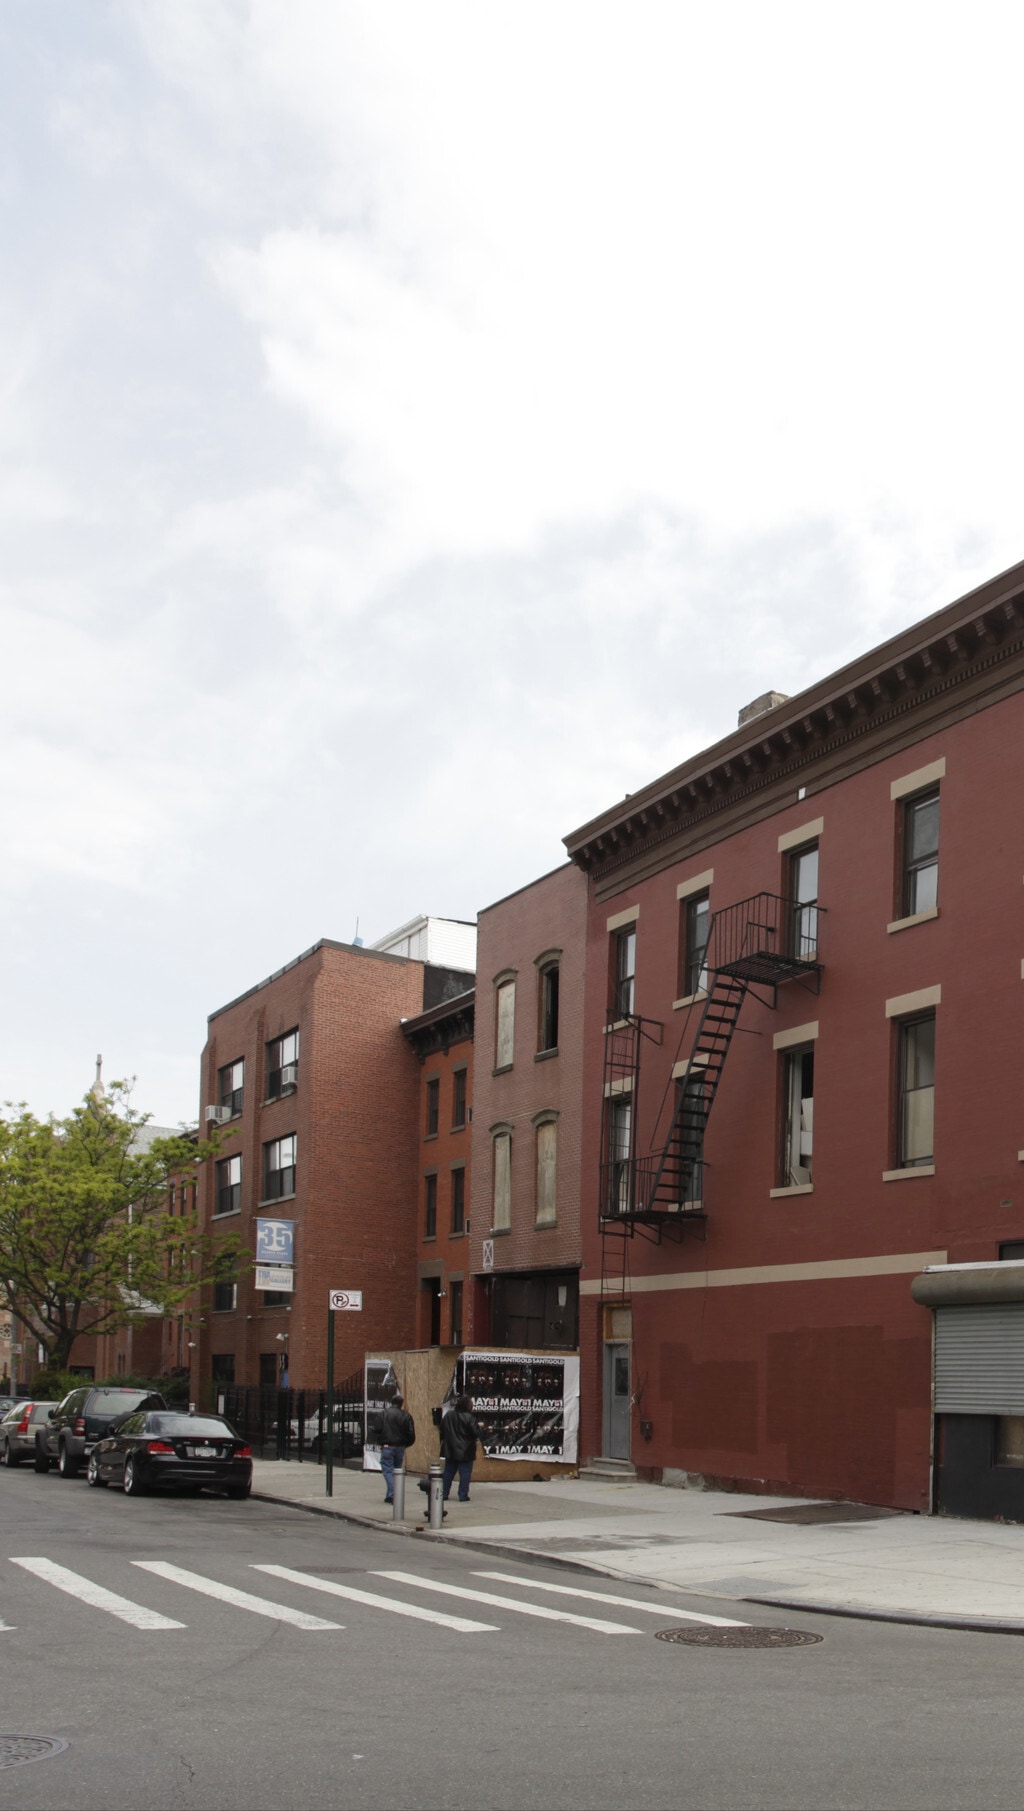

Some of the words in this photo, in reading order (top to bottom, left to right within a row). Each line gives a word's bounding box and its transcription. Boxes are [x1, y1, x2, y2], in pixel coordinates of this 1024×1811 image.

[259, 1225, 291, 1247] 35
[500, 1398, 521, 1406] MAY
[533, 1399, 554, 1407] MAY
[500, 1446, 523, 1454] MAY
[532, 1446, 554, 1454] MAY
